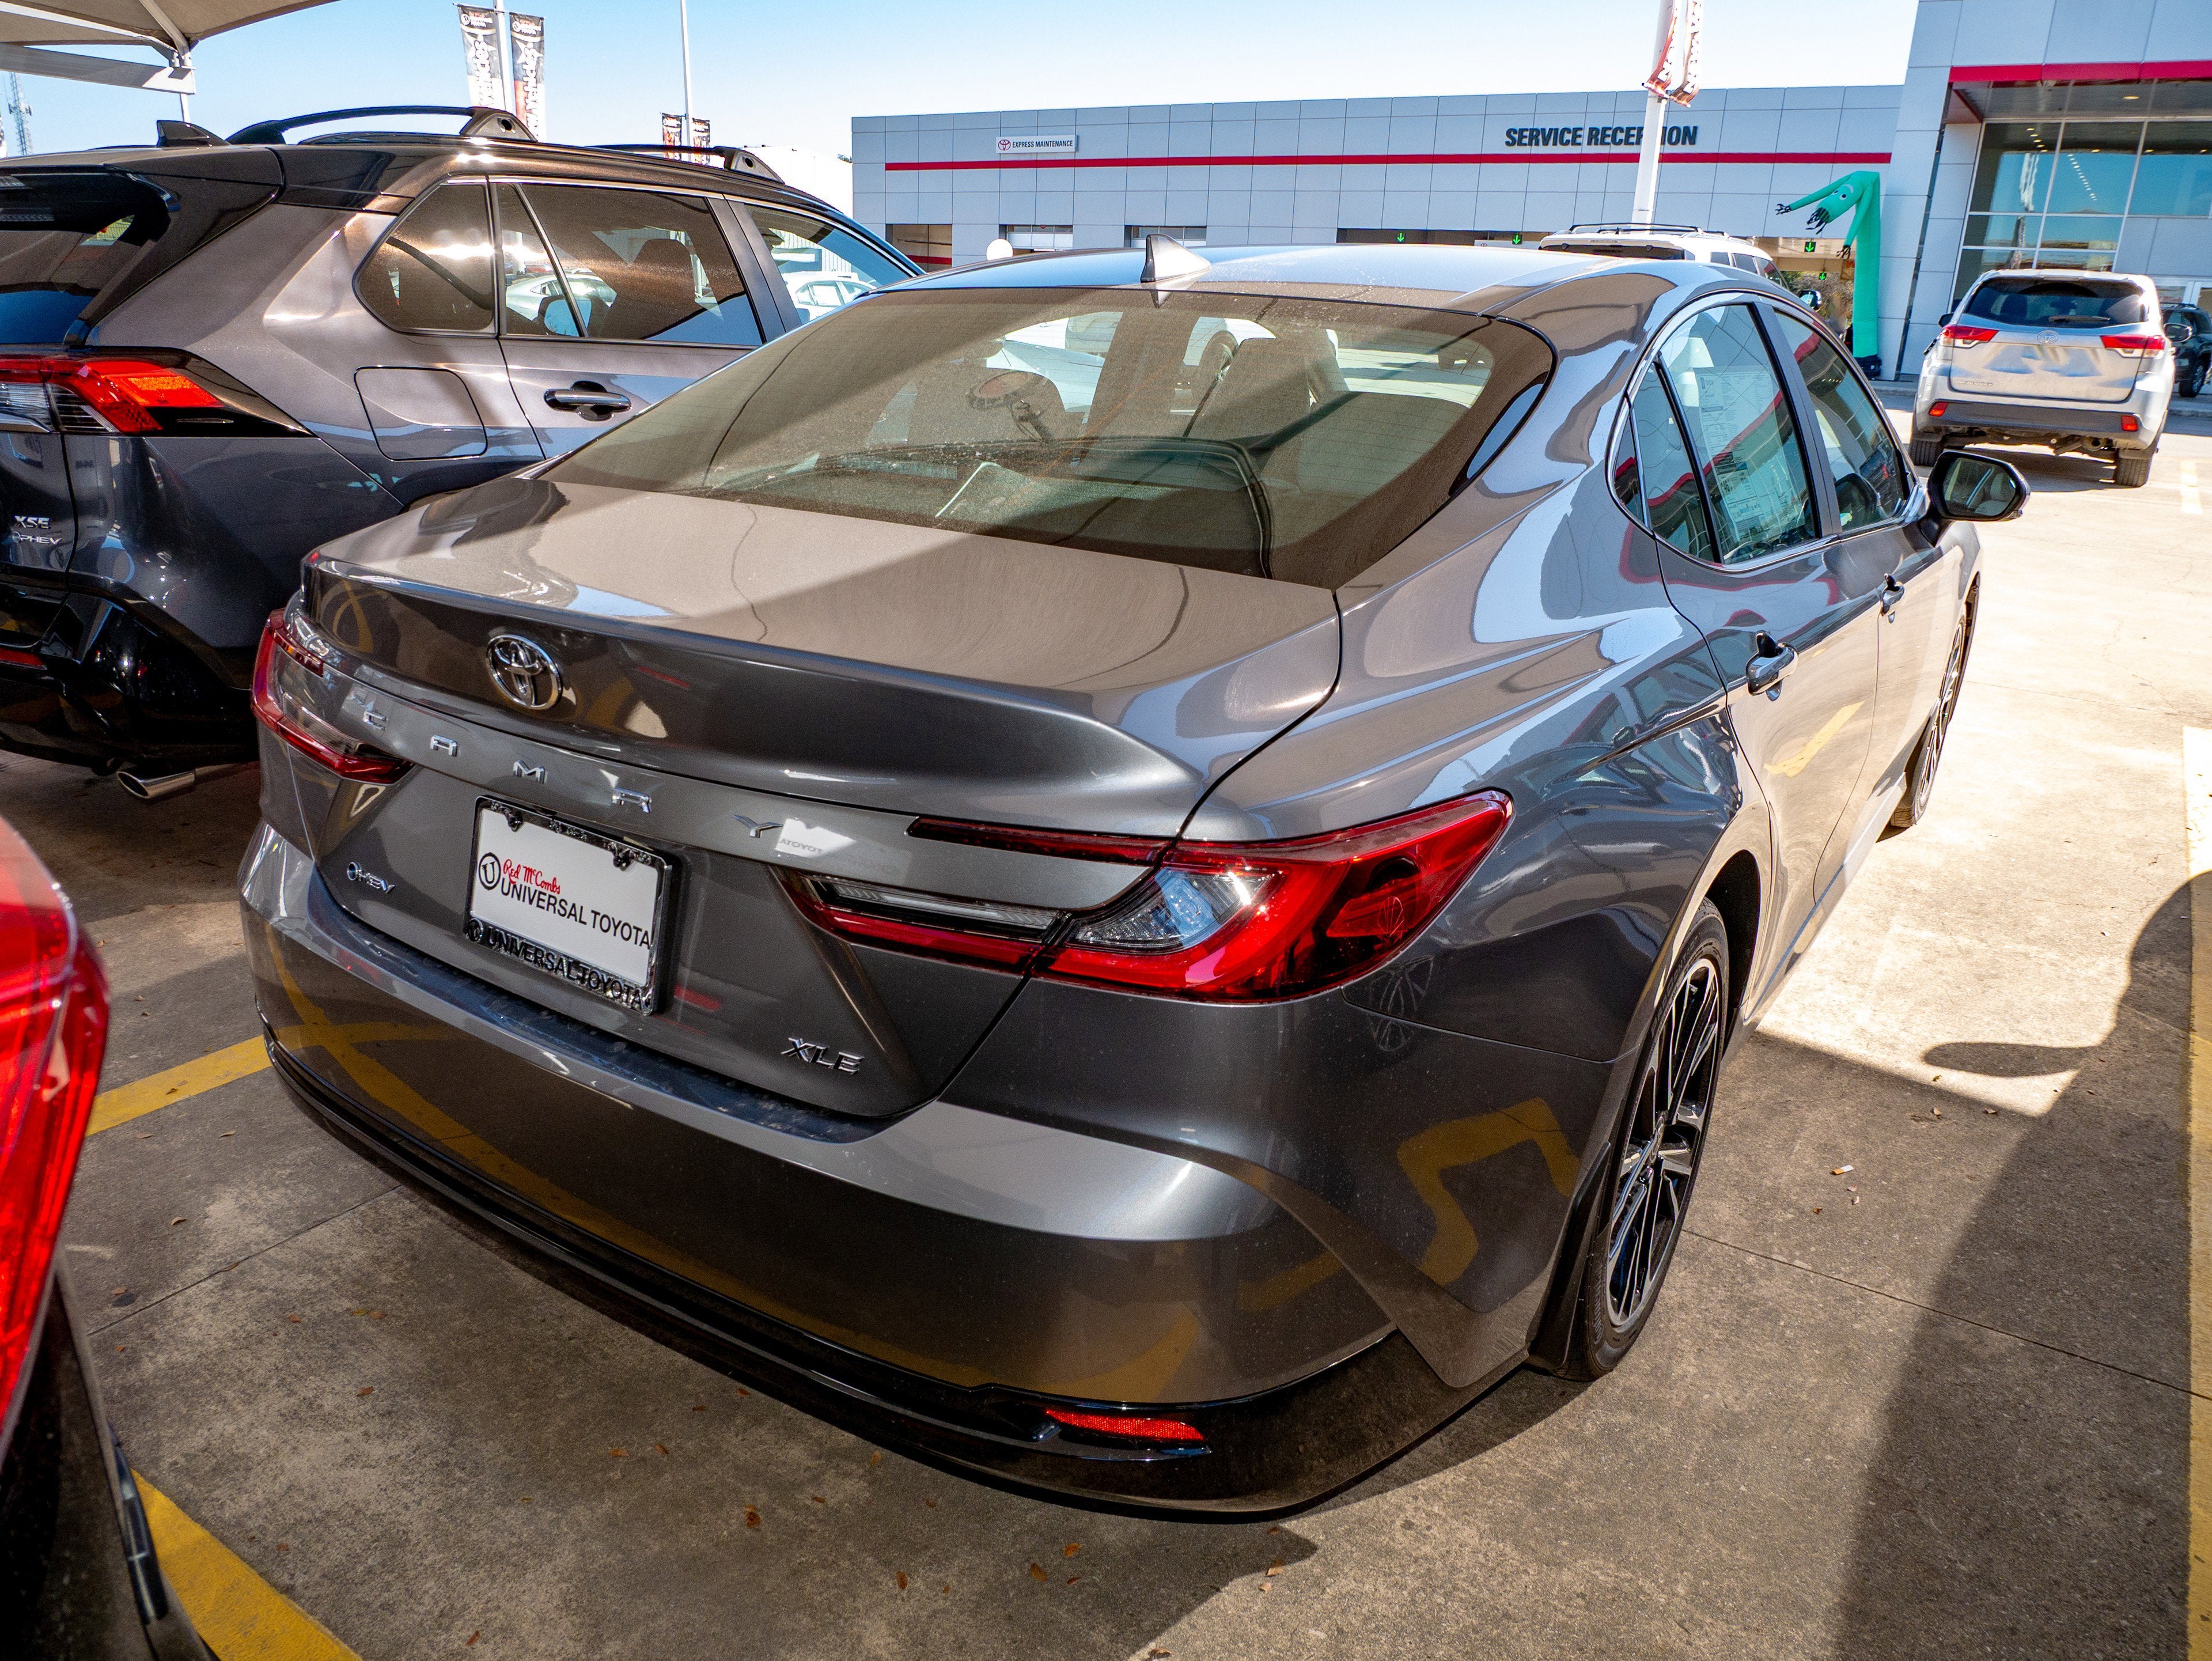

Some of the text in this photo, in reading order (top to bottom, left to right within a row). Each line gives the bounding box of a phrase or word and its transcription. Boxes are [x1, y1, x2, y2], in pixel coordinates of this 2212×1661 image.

[1505, 126, 1698, 146] SERVICE RECEPION
[14, 515, 51, 529] XSE
[503, 859, 560, 895] Red McCombs
[501, 877, 652, 950] UNIVERSAL TOYOTA
[488, 926, 645, 1010] UNIVERSAL TOYOTA
[781, 1038, 864, 1075] XLE
